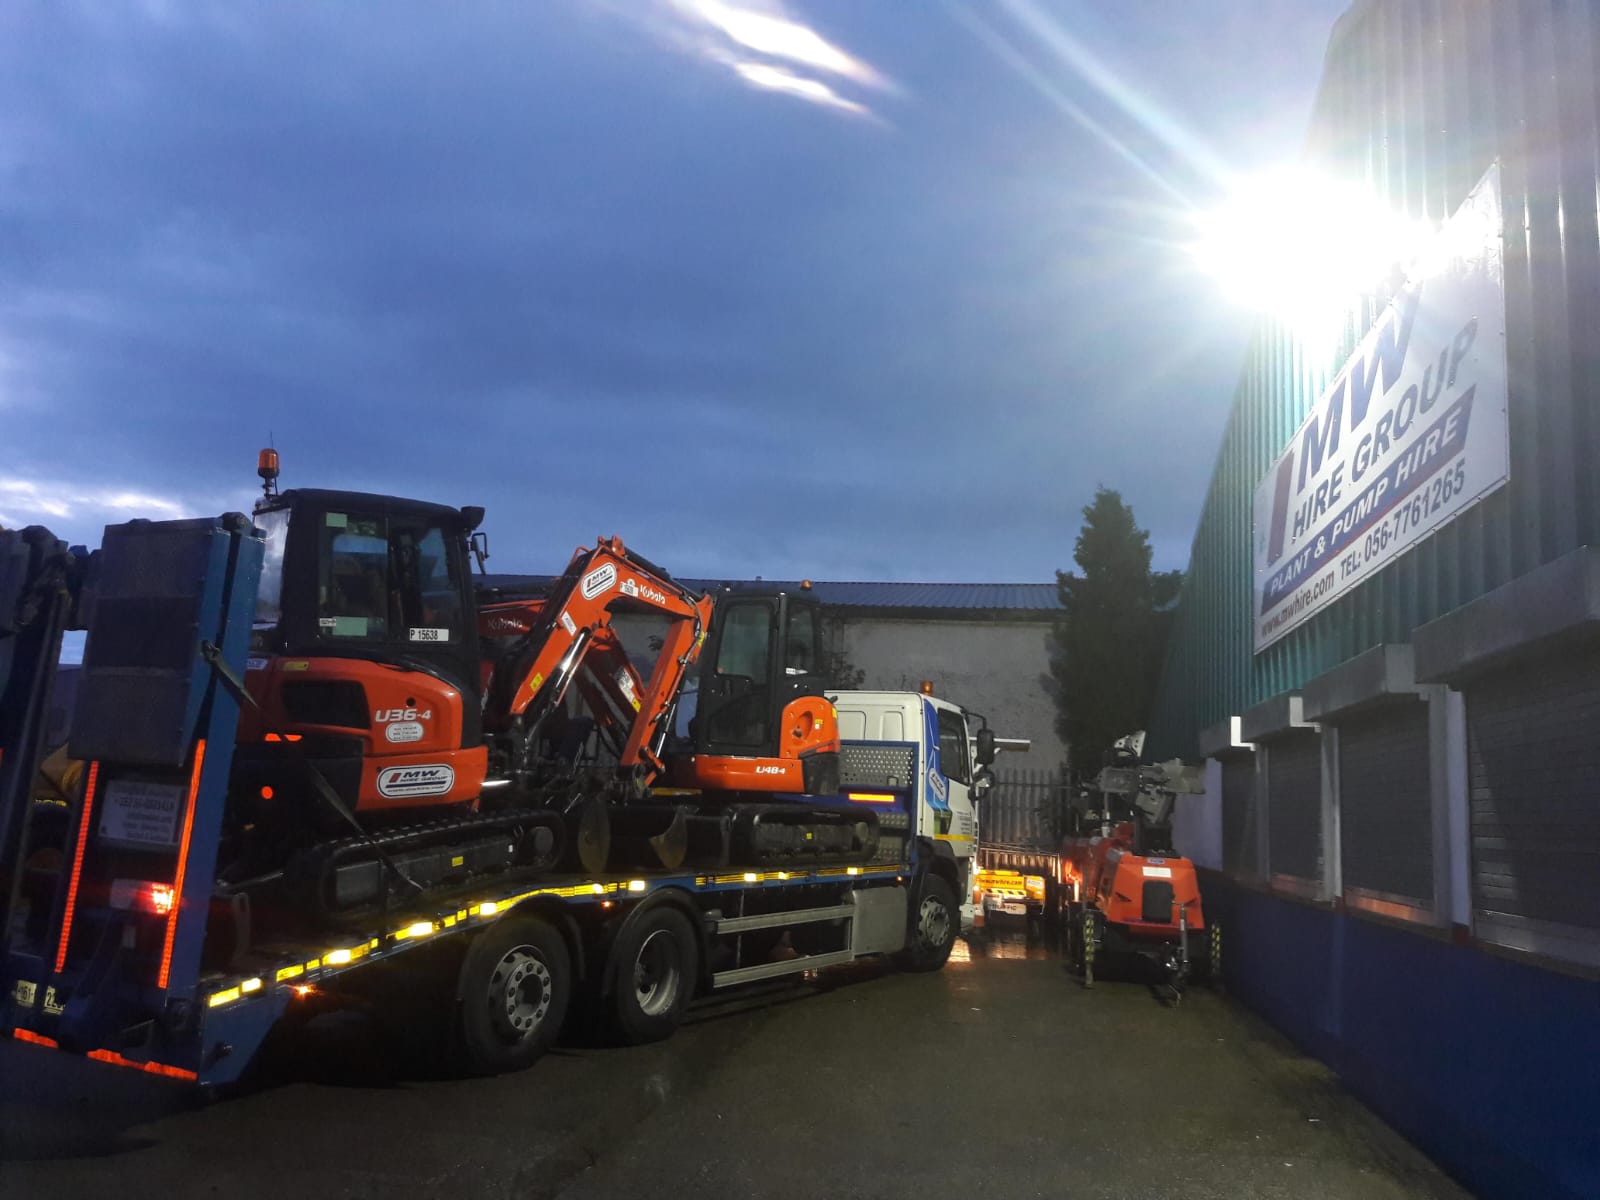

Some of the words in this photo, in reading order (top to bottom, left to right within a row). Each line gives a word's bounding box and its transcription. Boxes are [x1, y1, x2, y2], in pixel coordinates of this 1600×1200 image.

[1291, 471, 1344, 543] HIRE
[1352, 319, 1479, 484] GROUP
[1297, 282, 1424, 494] MW
[1261, 569, 1335, 637] www.mwhire.com
[1340, 551, 1361, 580] TEL:
[1364, 460, 1466, 563] 056-7761265
[1270, 549, 1311, 597] PLANT
[1314, 535, 1326, 557] &
[1331, 481, 1388, 547] PUMP
[1395, 414, 1461, 489] HIRE
[418, 629, 438, 640] 15638
[640, 584, 666, 605] Kubota
[374, 708, 432, 722] U36-4
[403, 769, 440, 778] MW
